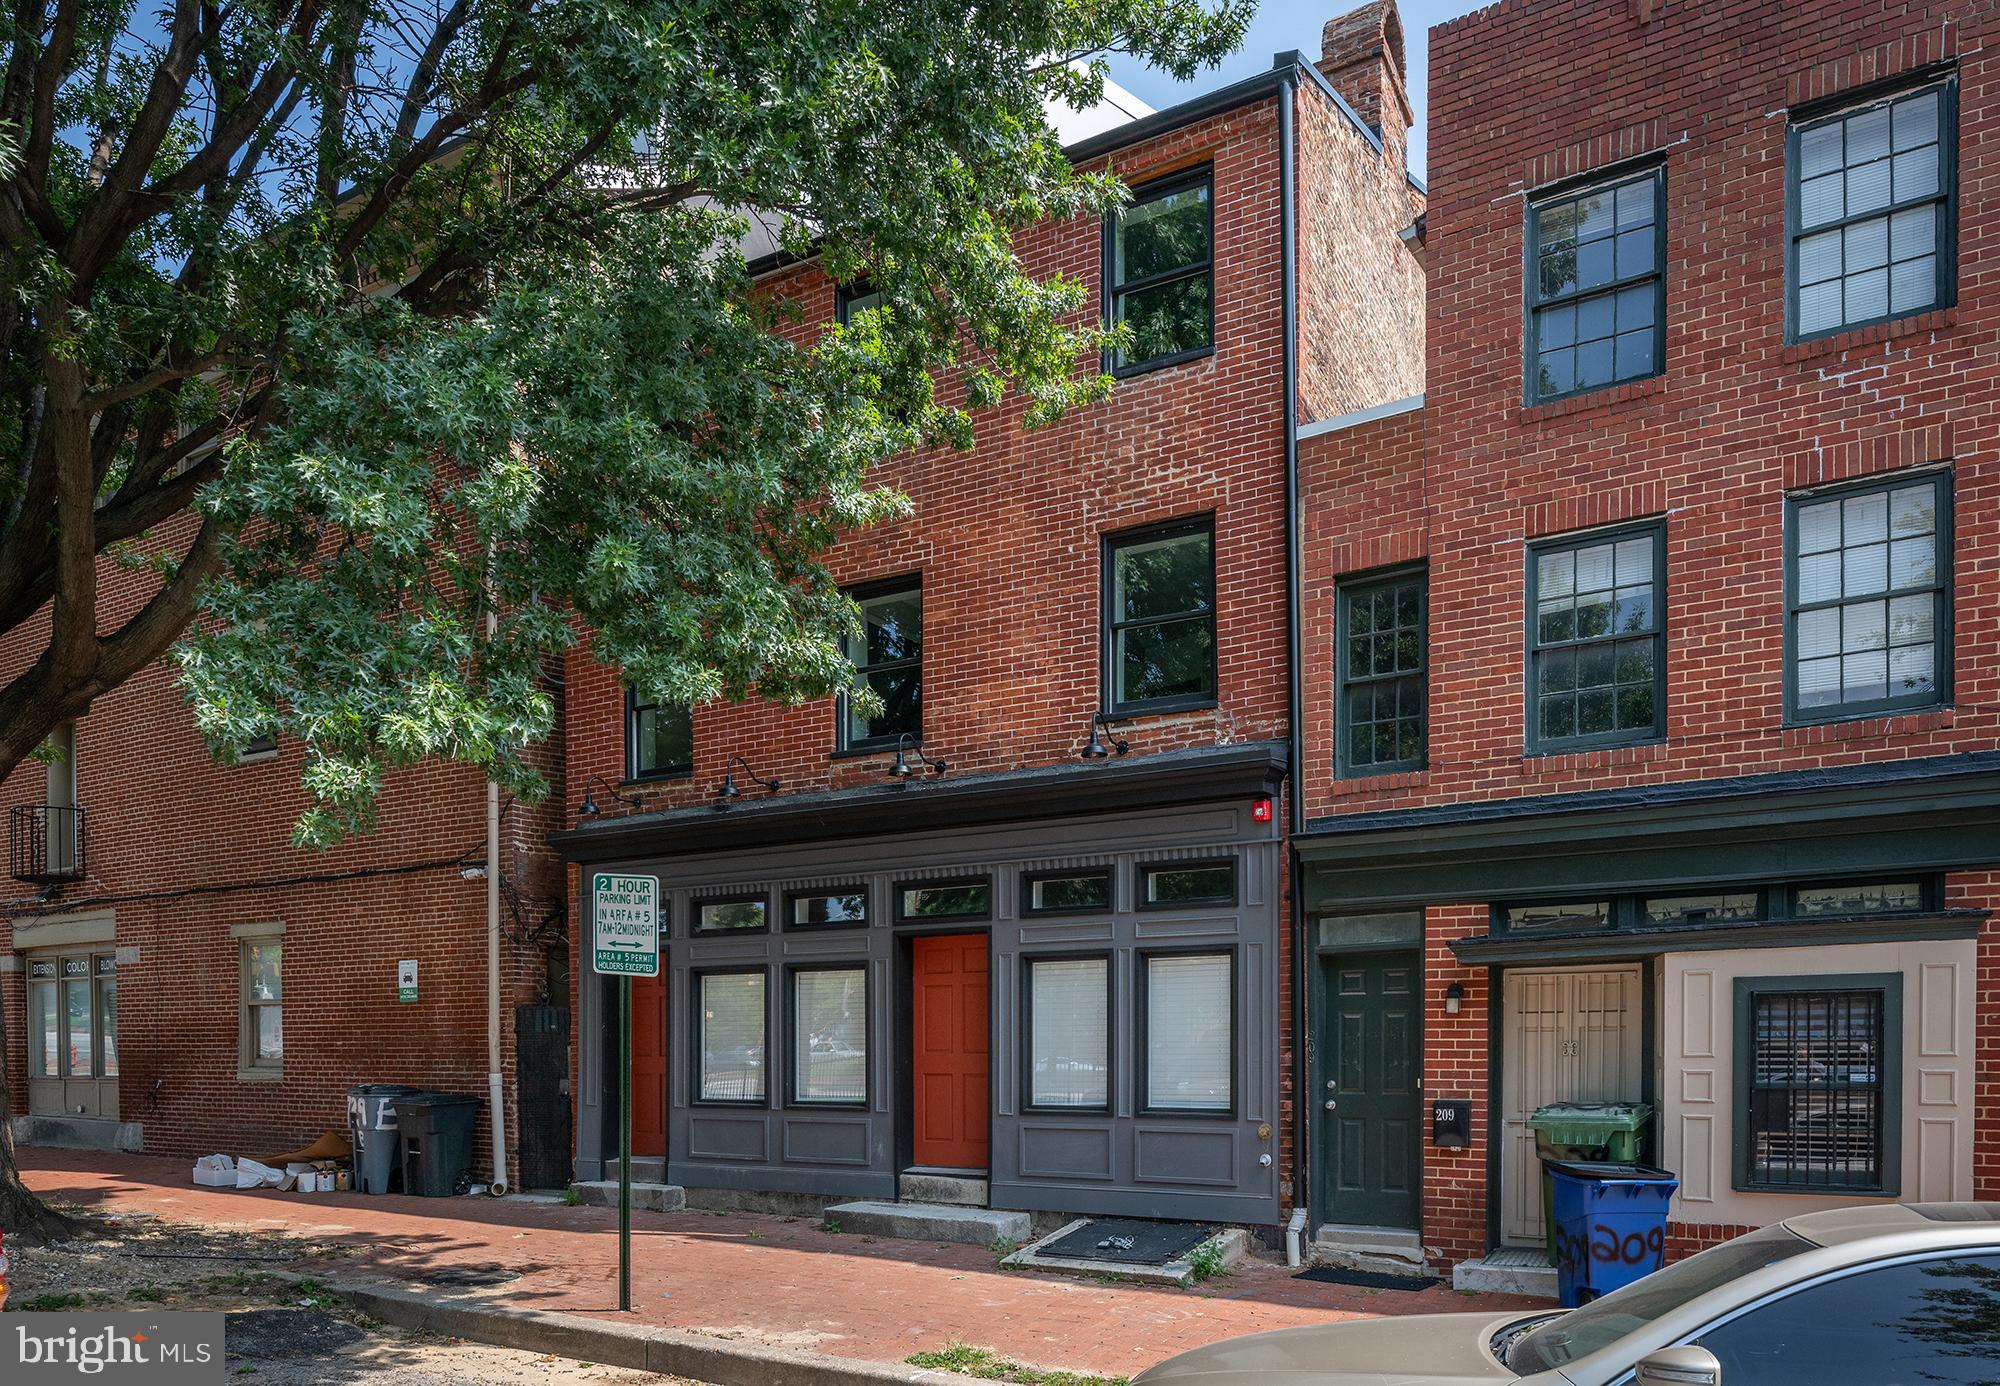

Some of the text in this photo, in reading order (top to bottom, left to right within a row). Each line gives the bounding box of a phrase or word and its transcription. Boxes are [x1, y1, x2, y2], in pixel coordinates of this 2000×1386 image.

[600, 878, 650, 893] 2 HOUR
[600, 893, 651, 905] PARKING LIMIT
[600, 908, 607, 919] IN
[635, 911, 641, 920] #
[644, 911, 650, 923] 5
[598, 952, 615, 960] AREA
[624, 953, 630, 961] 5
[631, 954, 654, 963] PERMIT
[598, 961, 654, 972] HOLDERS EXCEPTED
[1436, 1109, 1455, 1121] 209
[1591, 1224, 1664, 1272] 209
